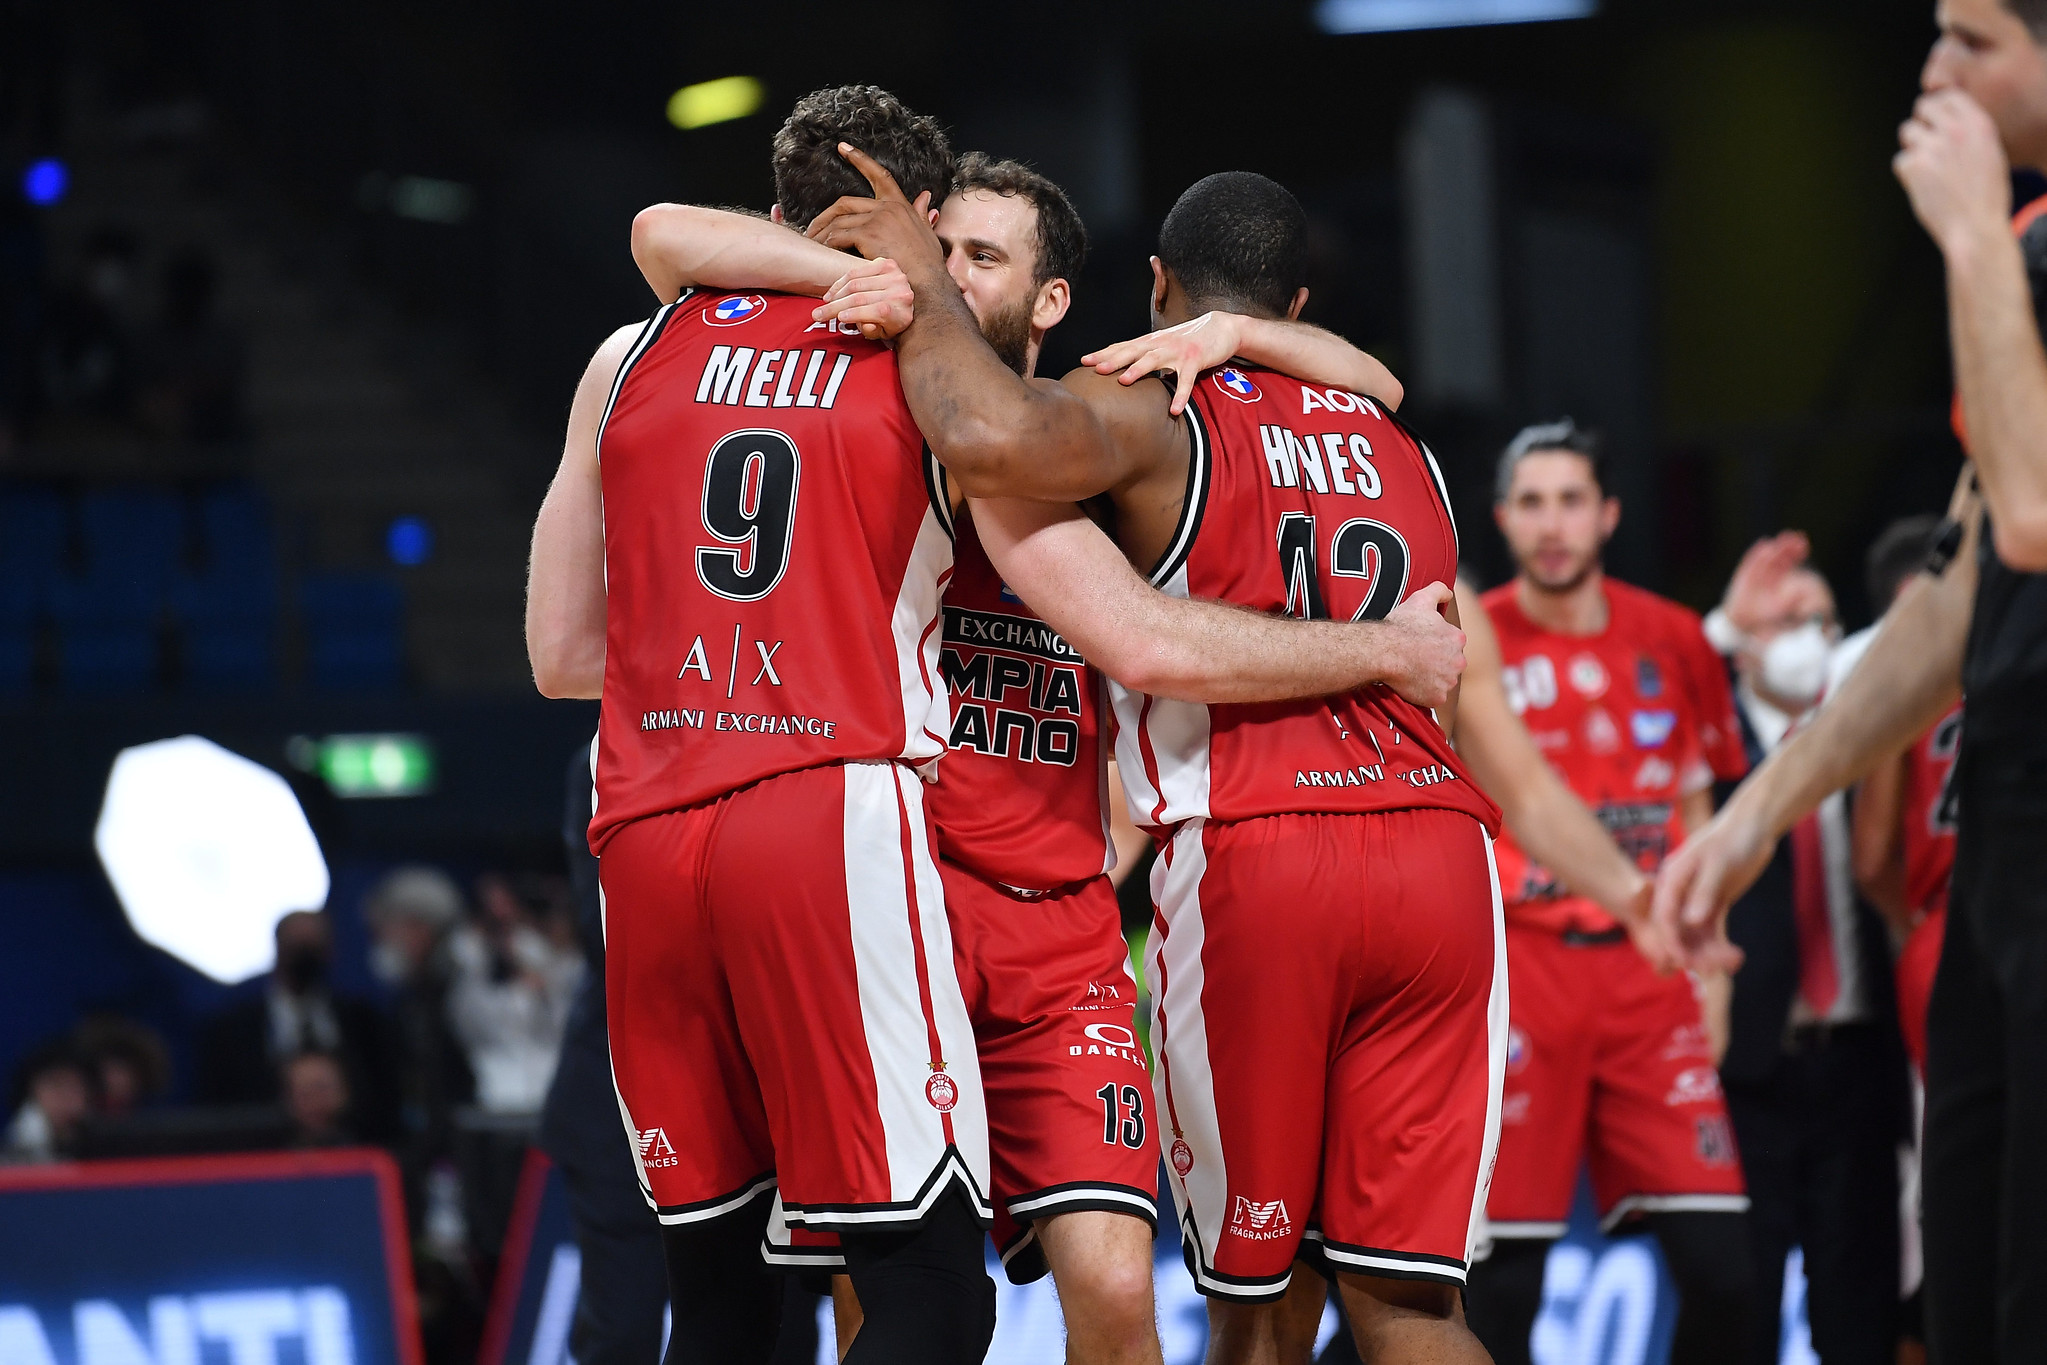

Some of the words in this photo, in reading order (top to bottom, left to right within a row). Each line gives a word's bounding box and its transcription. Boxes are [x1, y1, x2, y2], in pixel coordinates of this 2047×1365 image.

[695, 345, 853, 409] MELLI
[1300, 386, 1382, 420] AON
[1259, 424, 1383, 499] HINES
[695, 428, 801, 602] 9
[640, 708, 705, 731] ARMANI
[715, 711, 837, 739] EXCHANGE
[1294, 763, 1385, 788] ARMANI
[1069, 1044, 1147, 1072] OAKLEY
[1096, 1081, 1147, 1151] 13
[1229, 1225, 1293, 1241] FRAGRANCES
